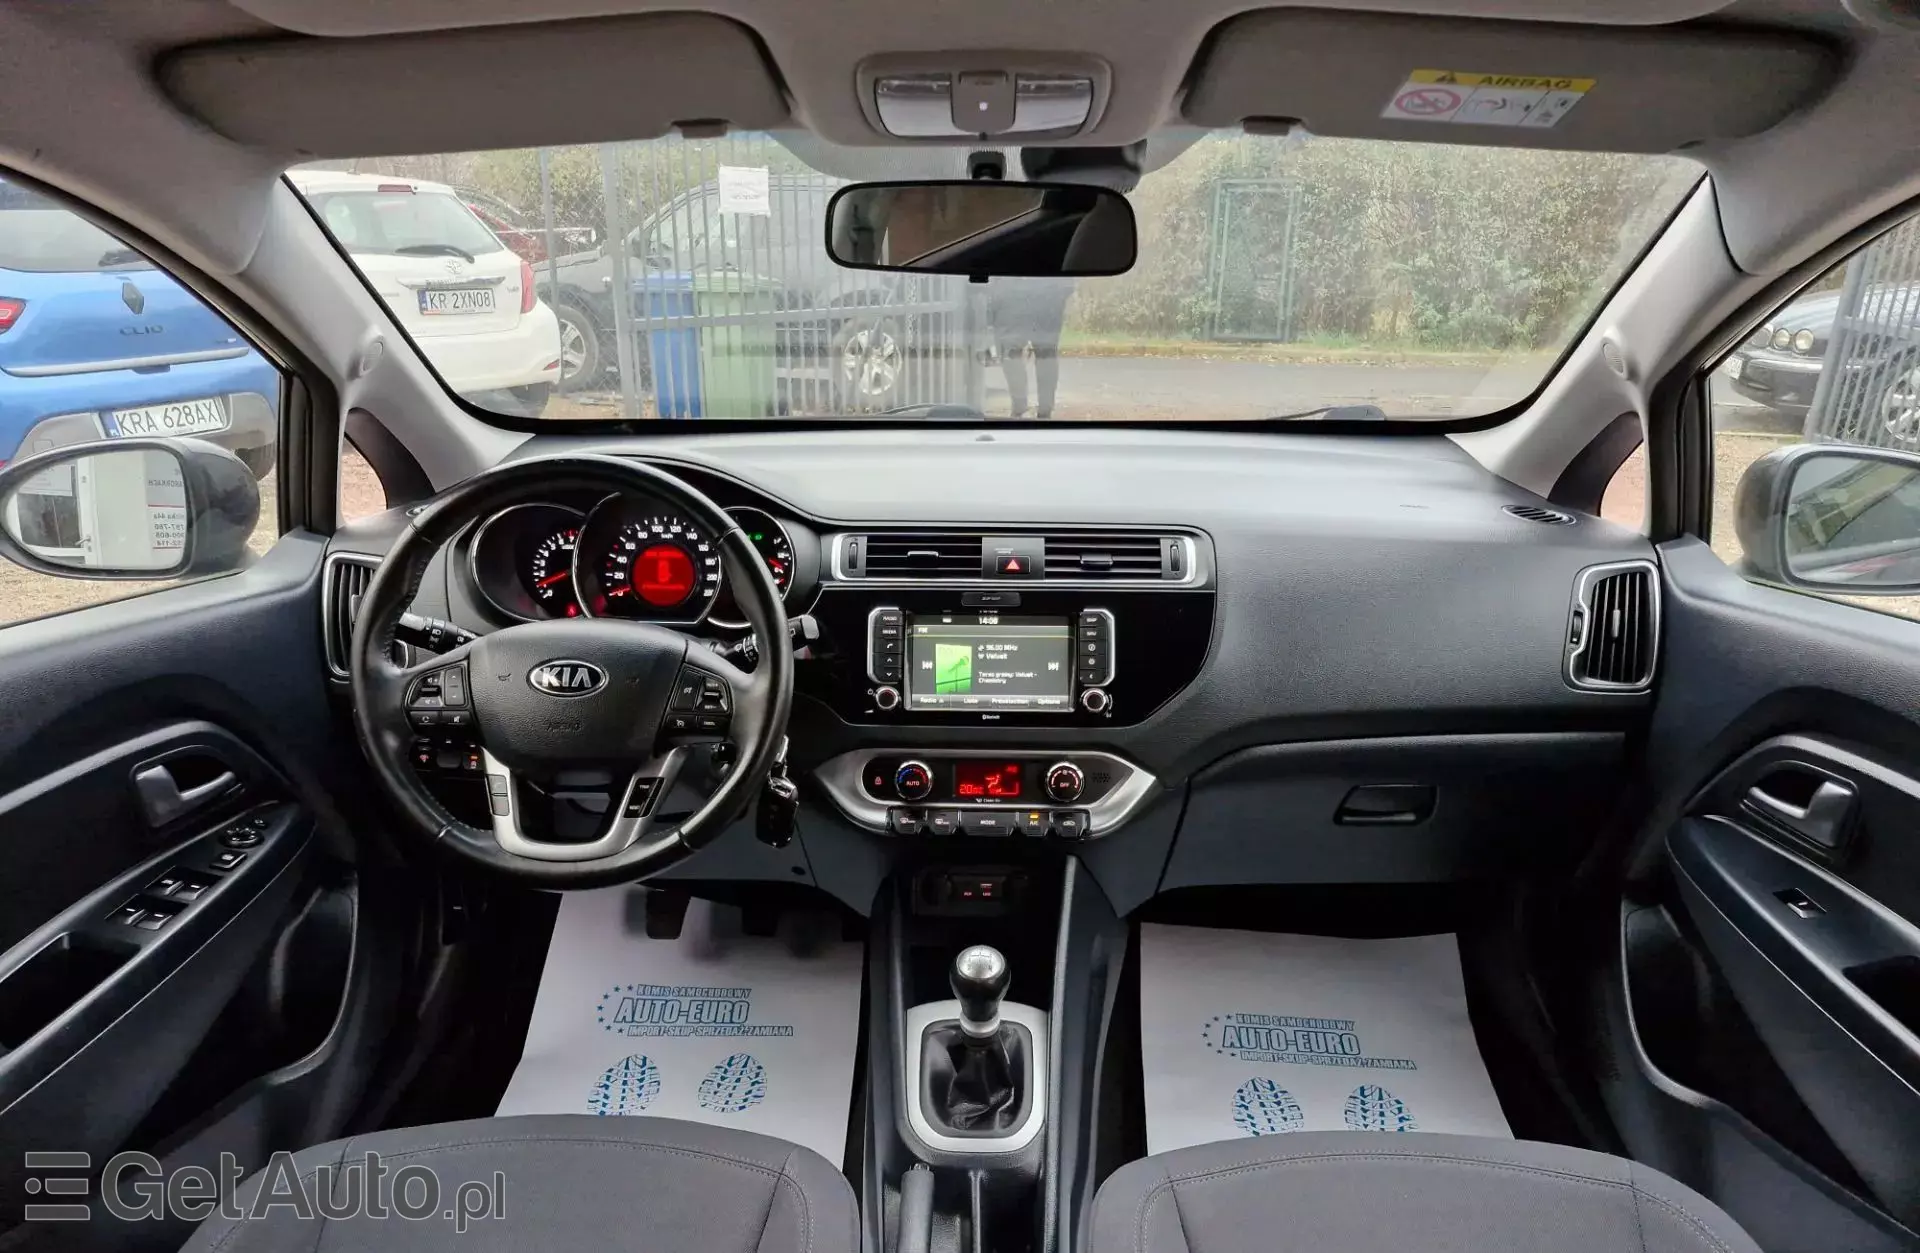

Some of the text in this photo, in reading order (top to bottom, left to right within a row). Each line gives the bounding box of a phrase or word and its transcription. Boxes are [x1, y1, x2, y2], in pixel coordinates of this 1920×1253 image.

[1478, 75, 1572, 89] AIRBAG
[428, 291, 491, 309] KR 2XN08
[119, 325, 164, 336] CLIO
[115, 401, 218, 436] KRA 628AX
[652, 525, 663, 533] 100
[670, 525, 681, 533] 120
[686, 532, 698, 540] 140
[617, 556, 627, 564] 40
[614, 572, 624, 580] 20
[541, 667, 592, 688] KIA
[636, 984, 752, 999] KOMIS SAMOCHODOWY
[614, 997, 750, 1024] AUTO-EURO
[1235, 1013, 1355, 1031] KOMIS SAMOCHODOWY
[1223, 1026, 1360, 1056] AUTO-EURO
